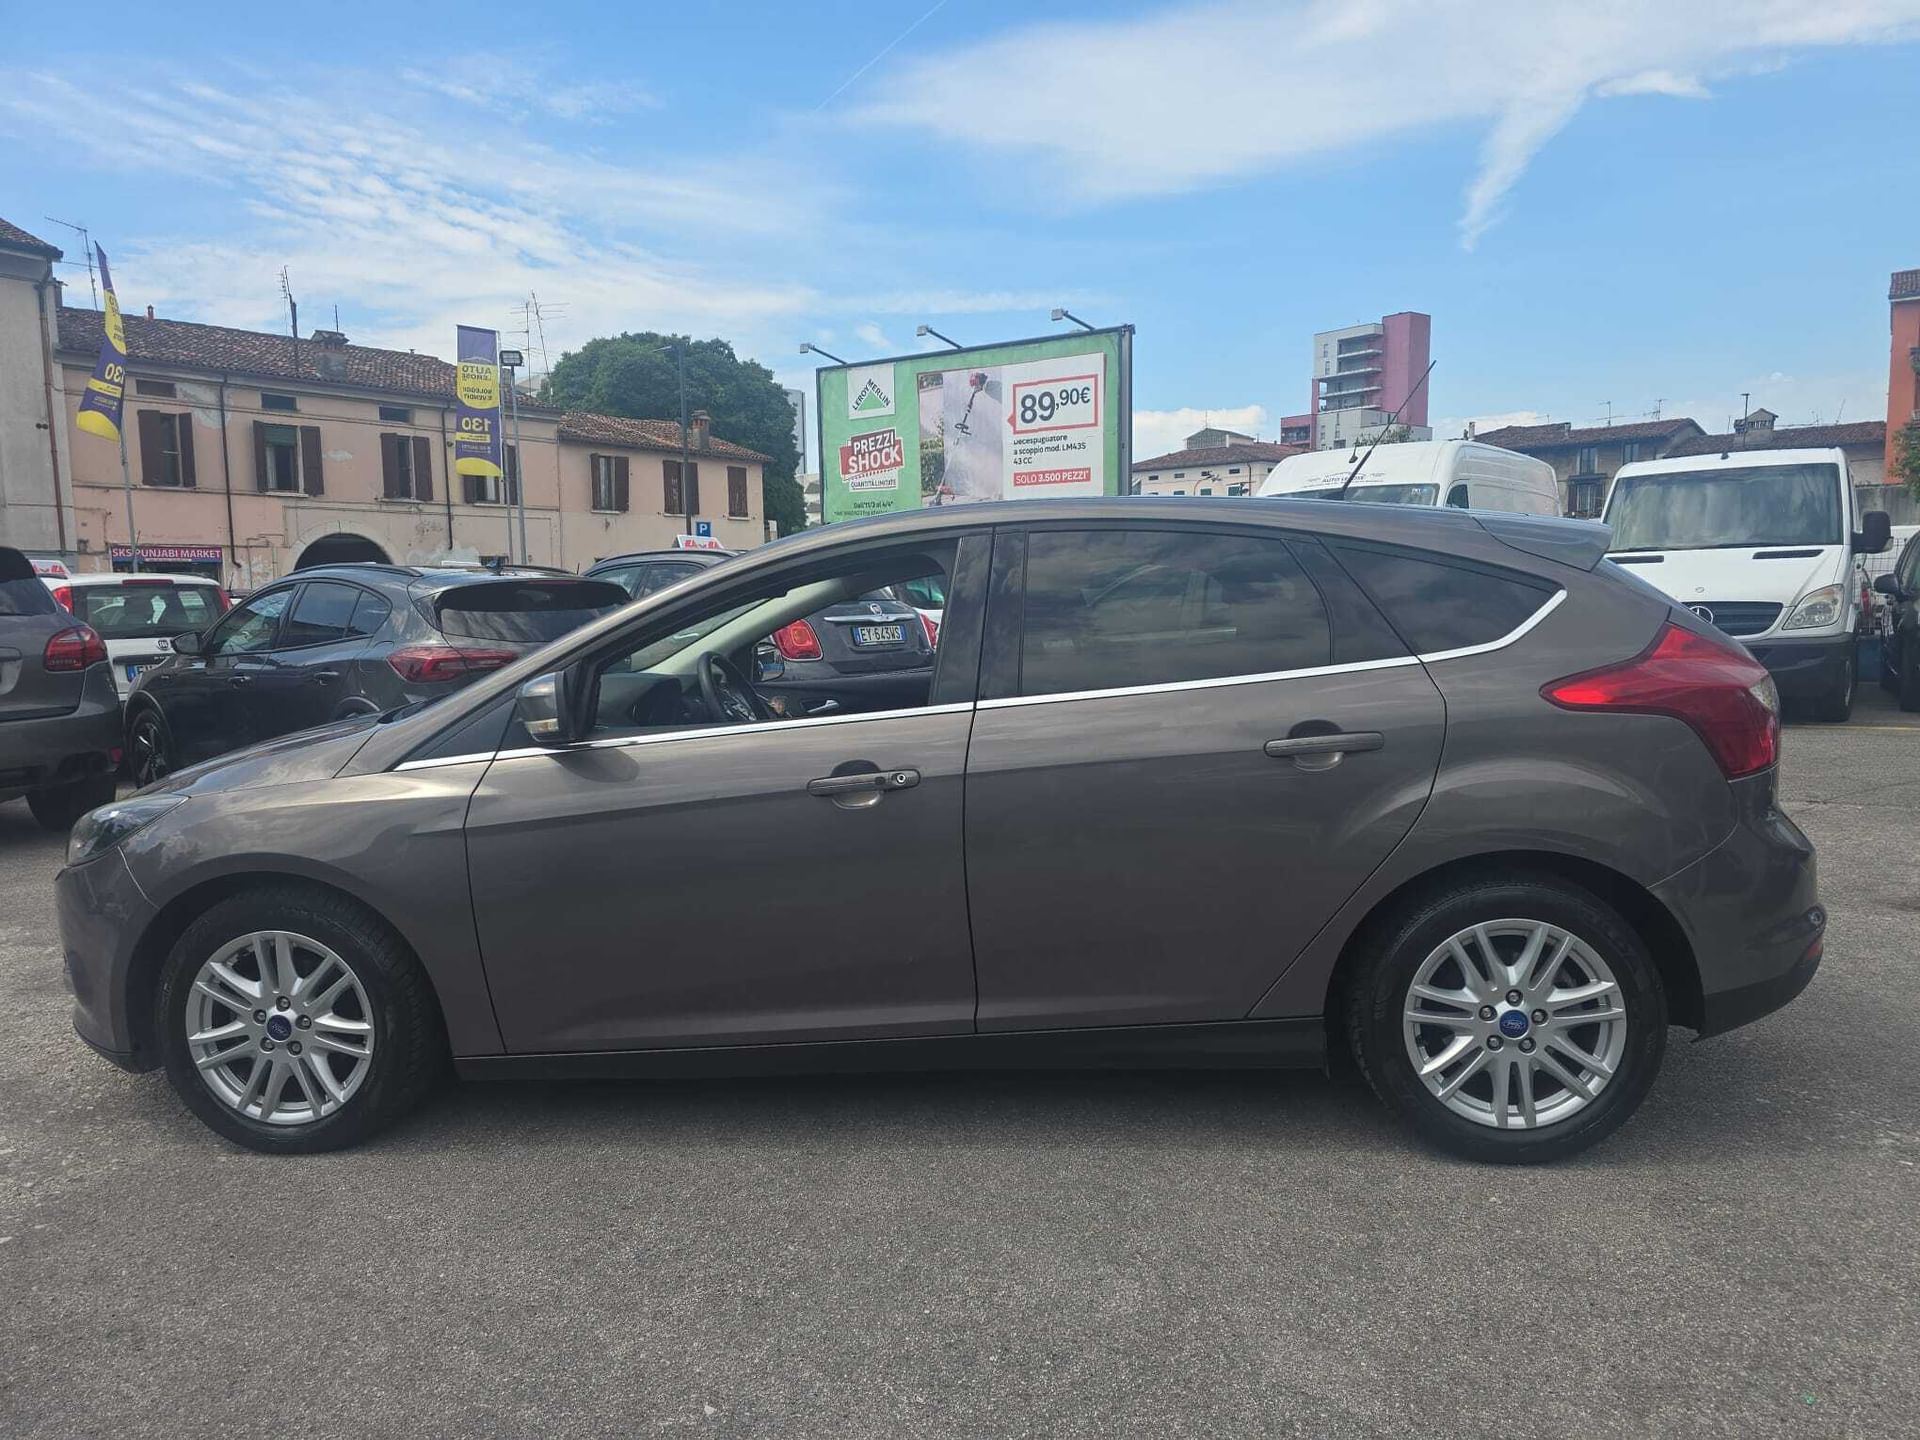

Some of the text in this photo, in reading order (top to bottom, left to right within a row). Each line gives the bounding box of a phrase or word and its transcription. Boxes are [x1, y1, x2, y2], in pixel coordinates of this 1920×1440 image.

[852, 378, 891, 411] LEROY MERLIN
[853, 431, 894, 455] PREZZI
[1019, 445, 1044, 456] scoppio
[1045, 443, 1061, 453] mod.
[848, 445, 901, 474] SHOCK
[1013, 456, 1033, 465] 43 CC
[1016, 474, 1038, 485] SOLO
[1038, 472, 1061, 483] 3.500
[699, 523, 708, 534] P
[112, 548, 132, 557] SKS
[180, 549, 221, 558] MARKET
